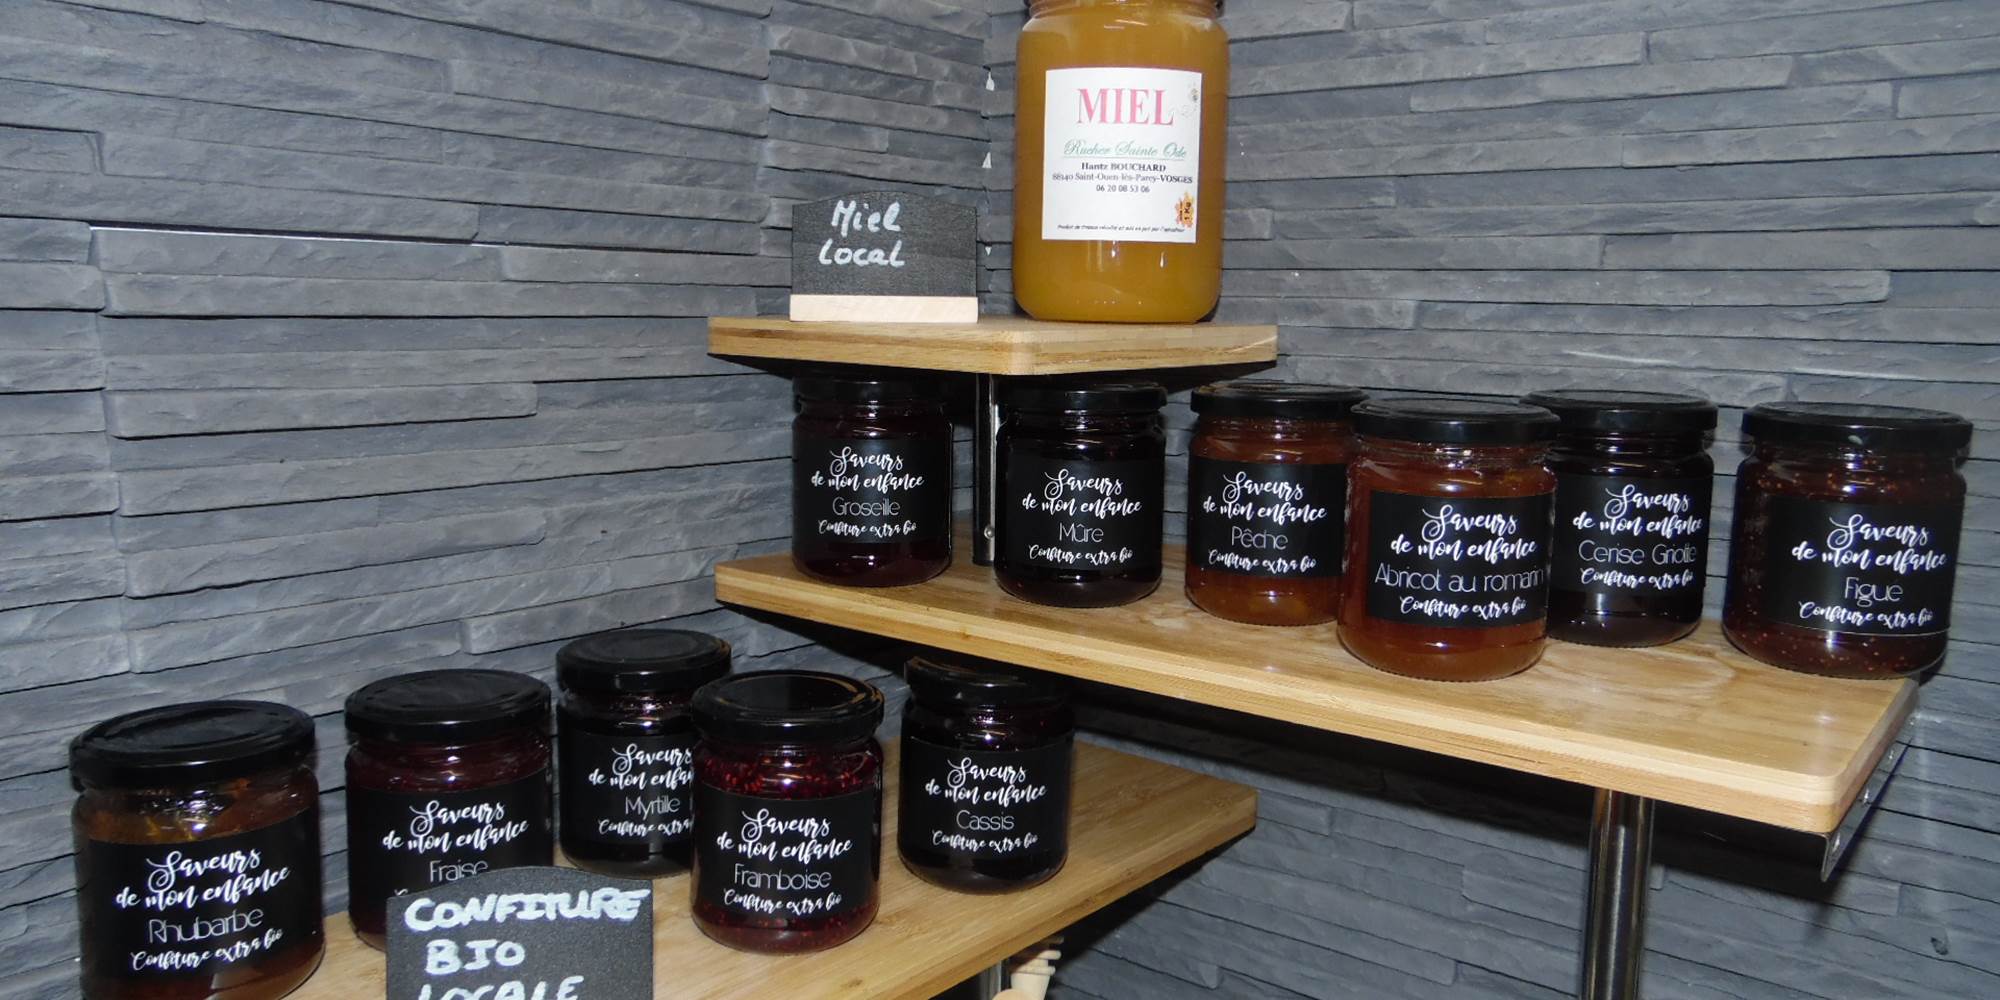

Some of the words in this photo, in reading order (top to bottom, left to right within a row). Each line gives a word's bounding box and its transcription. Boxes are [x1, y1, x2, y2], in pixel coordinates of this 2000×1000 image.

[1077, 88, 1173, 125] MIEL
[1064, 139, 1110, 156] Rucher
[1115, 141, 1157, 156] Sainte
[1163, 142, 1187, 158] Ode
[1111, 163, 1166, 172] BOUCHARD
[1141, 185, 1150, 193] 06
[831, 200, 901, 237] Miel
[819, 238, 905, 267] Local
[829, 446, 904, 476] Saveurs
[811, 470, 825, 487] de
[828, 474, 860, 491] mon
[863, 472, 925, 494] enfance
[1044, 469, 1123, 500] Saveurs
[1223, 471, 1304, 503] Saveurs
[832, 497, 900, 516] Groseille
[1022, 493, 1039, 510] de
[1041, 498, 1077, 516] mon
[1080, 497, 1142, 519] enfance
[1203, 496, 1217, 513] de
[1220, 502, 1254, 520] mon
[1257, 502, 1327, 525] enfance
[1604, 484, 1690, 519] Saveurs
[818, 520, 867, 537] Confiture
[870, 523, 901, 538] extra
[903, 520, 916, 535] bio
[1059, 522, 1104, 543] Mûre
[1421, 504, 1518, 542] Saveurs
[1573, 511, 1595, 530] de
[1600, 516, 1643, 536] mon
[1646, 515, 1702, 538] enfance
[1827, 514, 1929, 550] Saveurs
[1231, 526, 1288, 550] Pêche
[1391, 534, 1413, 554] de
[1418, 539, 1463, 561] mon
[1467, 537, 1537, 564] enfance
[1579, 540, 1645, 564] Cerise
[1029, 544, 1083, 564] Confiture
[1085, 550, 1117, 566] extra
[1120, 547, 1133, 563] bio
[1208, 550, 1259, 568] Confiture
[1262, 557, 1298, 574] extra
[1300, 555, 1317, 572] bio
[1792, 541, 1816, 561] de
[1822, 549, 1871, 570] mon
[1875, 548, 1947, 574] enfance
[1375, 562, 1442, 592] Abricot
[1449, 574, 1476, 593] au
[1580, 567, 1646, 589] Confiture
[1649, 573, 1680, 590] extra
[1682, 569, 1693, 586] bio
[1844, 576, 1903, 607] Figue
[1400, 596, 1469, 618] Confiture
[1472, 600, 1509, 620] extra
[1512, 596, 1527, 616] bio
[1799, 602, 1874, 626] Confiture
[1877, 613, 1916, 629] extra
[1918, 607, 1933, 626] bio
[612, 743, 692, 775] Saveurs
[947, 757, 1027, 788] Saveurs
[588, 768, 607, 785] de
[610, 772, 648, 790] mon
[925, 779, 941, 795] de
[945, 786, 980, 805] mon
[984, 784, 1047, 807] enfance
[409, 800, 505, 837] Saveurs
[625, 795, 680, 820] Myrtille
[956, 809, 1014, 831] Cassis
[382, 830, 404, 850] de
[407, 832, 452, 853] mon
[456, 820, 529, 851] enfance
[598, 819, 656, 836] Confiture
[741, 808, 831, 843] Saveurs
[717, 831, 734, 850] de
[738, 840, 778, 862] mon
[781, 838, 853, 864] enfance
[932, 830, 986, 852] Confiture
[989, 837, 1021, 853] extra
[1024, 832, 1038, 848] bio
[146, 850, 261, 893] Saveurs
[430, 859, 488, 882] Fraise
[734, 863, 832, 890] Framboise
[116, 886, 140, 909] de
[145, 885, 199, 912] mon
[203, 867, 291, 904] enfance
[724, 888, 783, 914] Confiture
[786, 898, 823, 915] extra
[826, 892, 842, 910] bio
[404, 887, 650, 932] CONFITURE
[149, 908, 264, 944] Rhubarbe
[131, 951, 214, 971] Confiture
[215, 936, 261, 962] extra
[264, 928, 283, 950] bio
[425, 939, 525, 975] BIO
